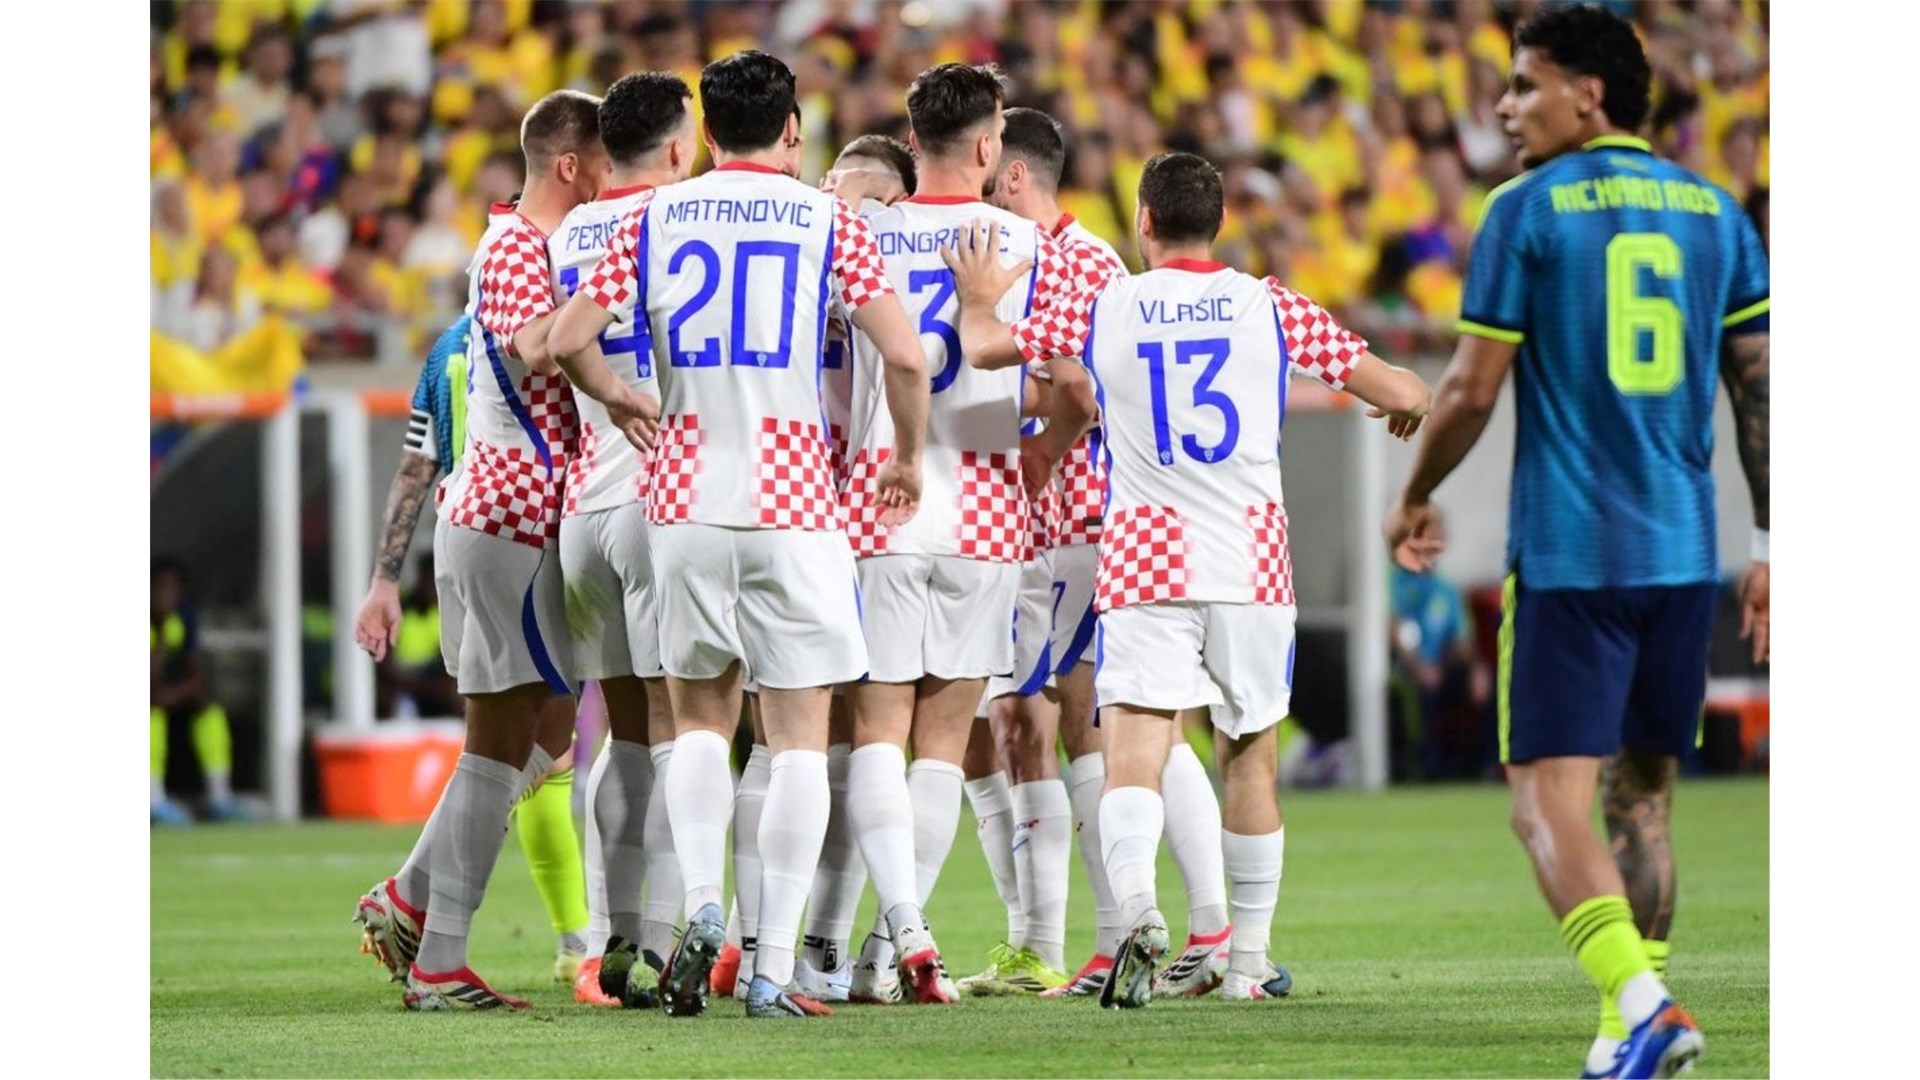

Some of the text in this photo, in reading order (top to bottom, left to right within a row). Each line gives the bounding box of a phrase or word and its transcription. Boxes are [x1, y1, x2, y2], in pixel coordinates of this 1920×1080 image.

[665, 199, 812, 228] MATANOVIĆ
[668, 240, 800, 367] 20
[908, 268, 962, 394] 3
[1139, 293, 1233, 323] VLAŠIĆ
[1606, 232, 1684, 396] 6
[1137, 338, 1240, 465] 13
